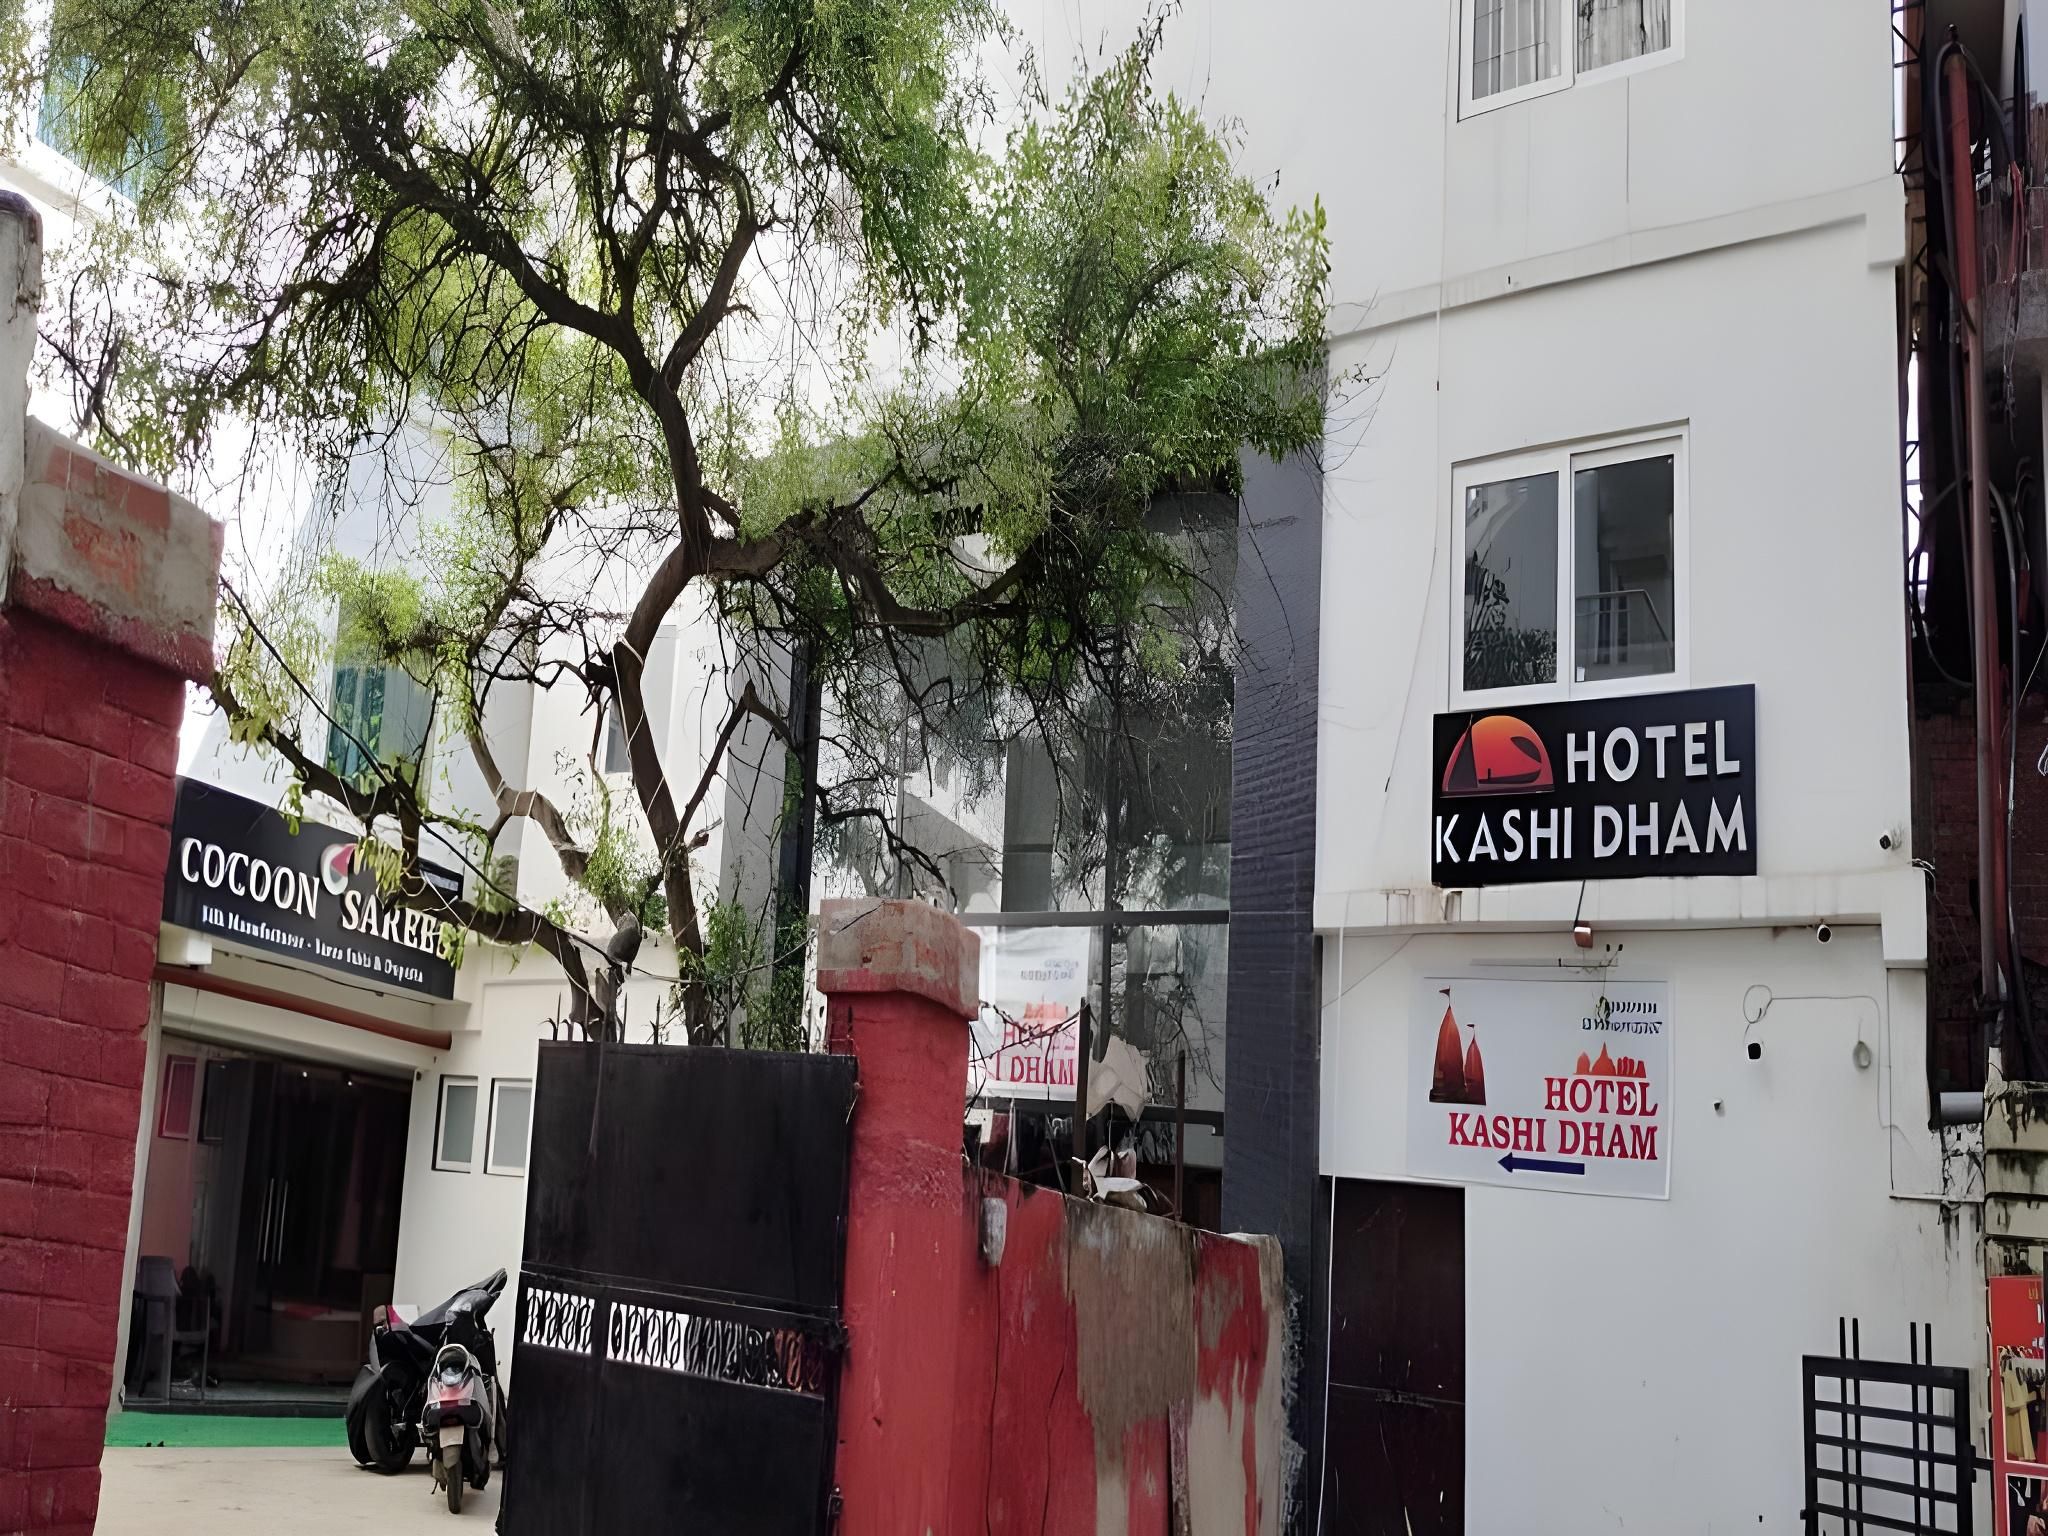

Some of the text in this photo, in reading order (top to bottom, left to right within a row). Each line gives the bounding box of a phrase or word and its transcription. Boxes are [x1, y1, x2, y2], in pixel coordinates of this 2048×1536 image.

[1566, 719, 1740, 783] HOTEL
[1435, 794, 1748, 864] KASHI DHAM
[181, 837, 320, 919] COCOON
[1009, 1056, 1076, 1086] DHAM
[1544, 1077, 1659, 1117] HOTEL
[1448, 1112, 1658, 1161] KASHI DHAM
